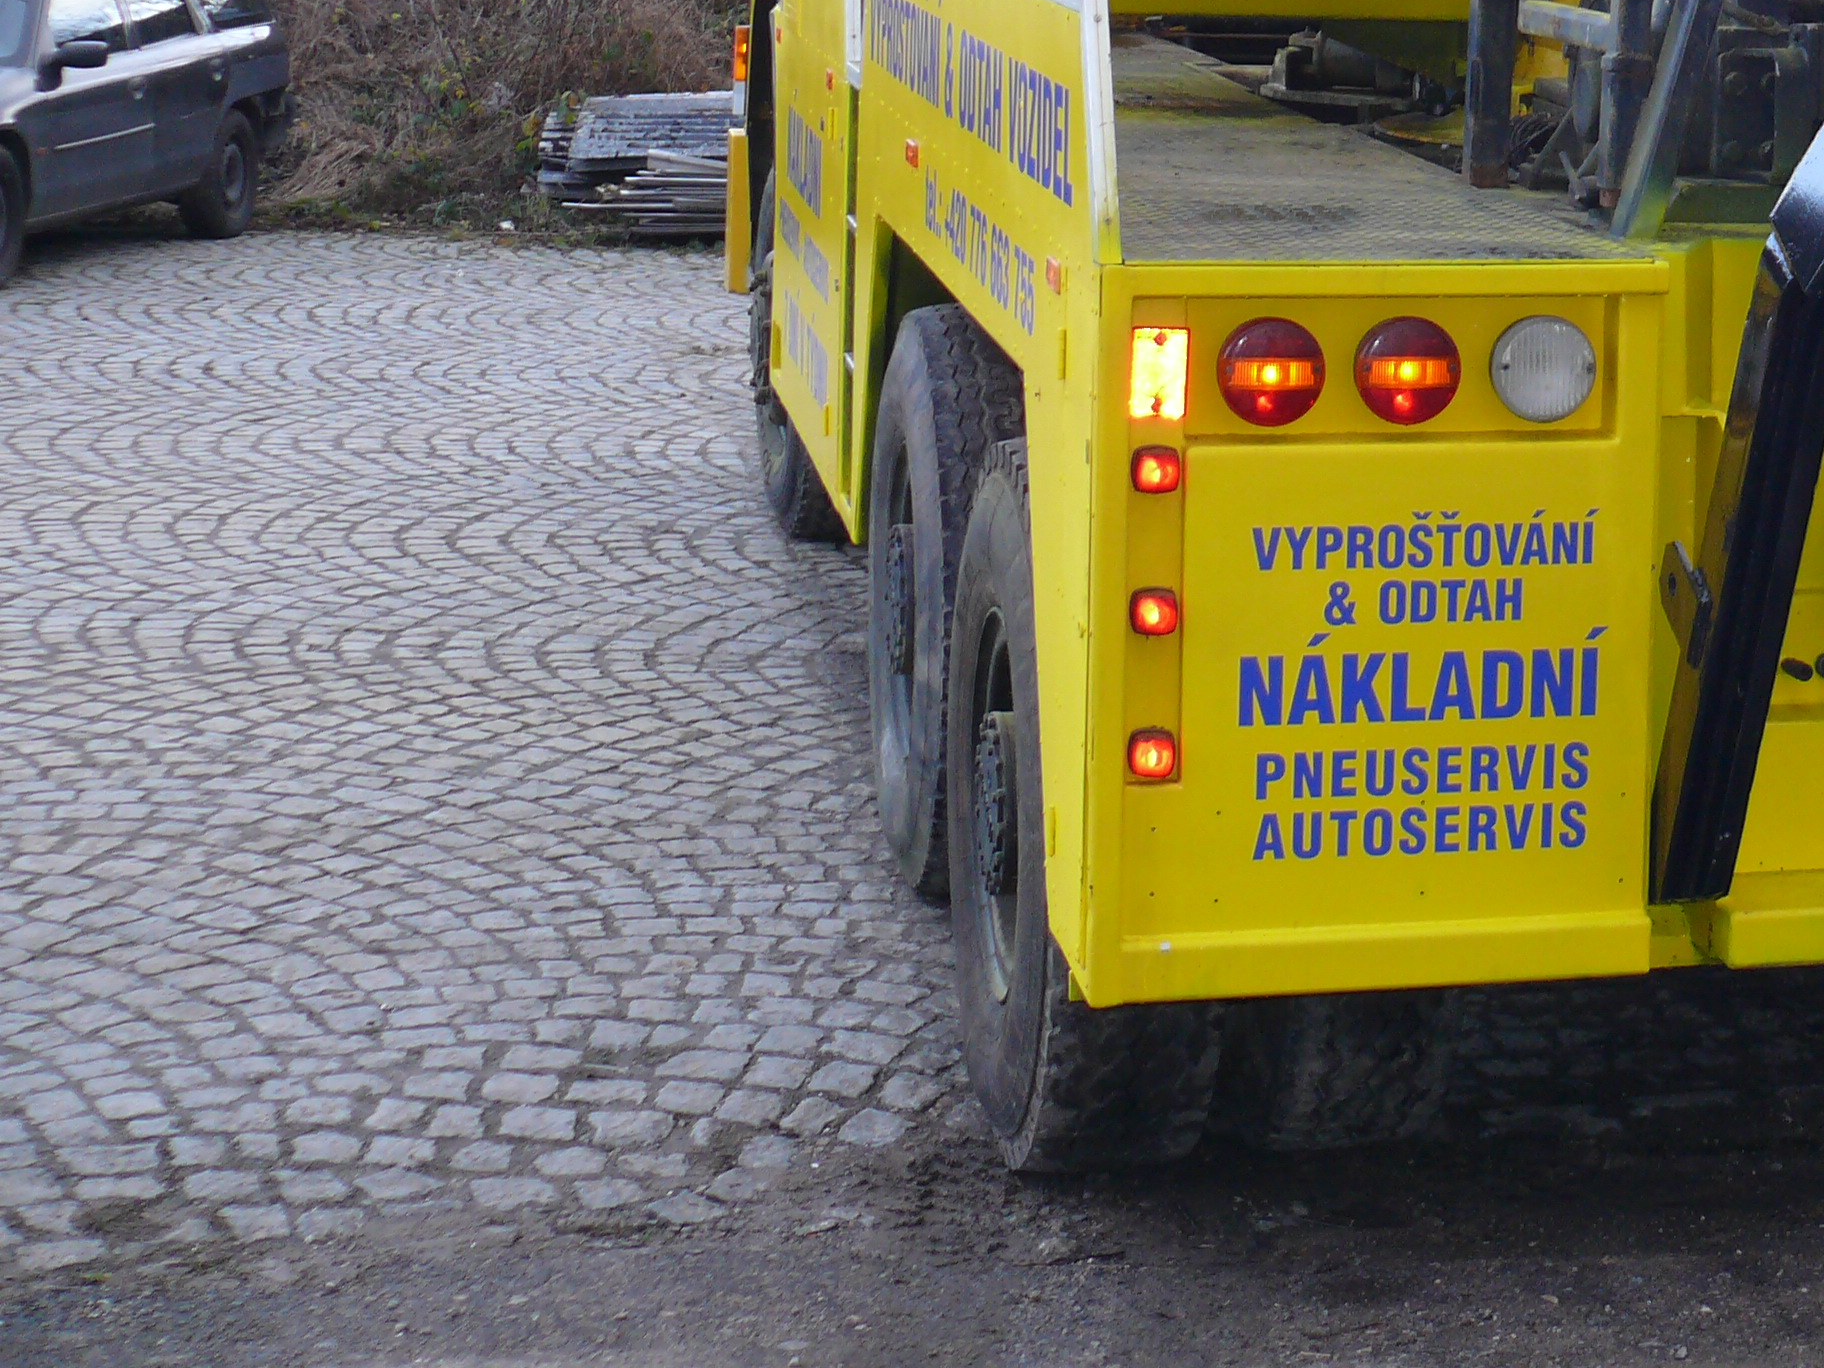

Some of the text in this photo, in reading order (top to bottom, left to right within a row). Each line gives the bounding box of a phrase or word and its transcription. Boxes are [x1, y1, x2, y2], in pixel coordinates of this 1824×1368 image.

[944, 21, 954, 119] &
[958, 28, 1004, 155] ODTAH
[1008, 56, 1074, 208] VOZIDEL
[944, 188, 969, 266] +420
[969, 203, 989, 288] 776
[990, 222, 1010, 311] 663
[1013, 244, 1036, 337] 755
[1251, 507, 1601, 572] VYPROŠŤOVÁNÍ
[1323, 577, 1524, 626] & ODTAH
[1237, 625, 1610, 728] NÁKLADNÍ
[1254, 740, 1591, 801] PNEUSERVIS
[1251, 800, 1589, 862] AUTOSERVIS
